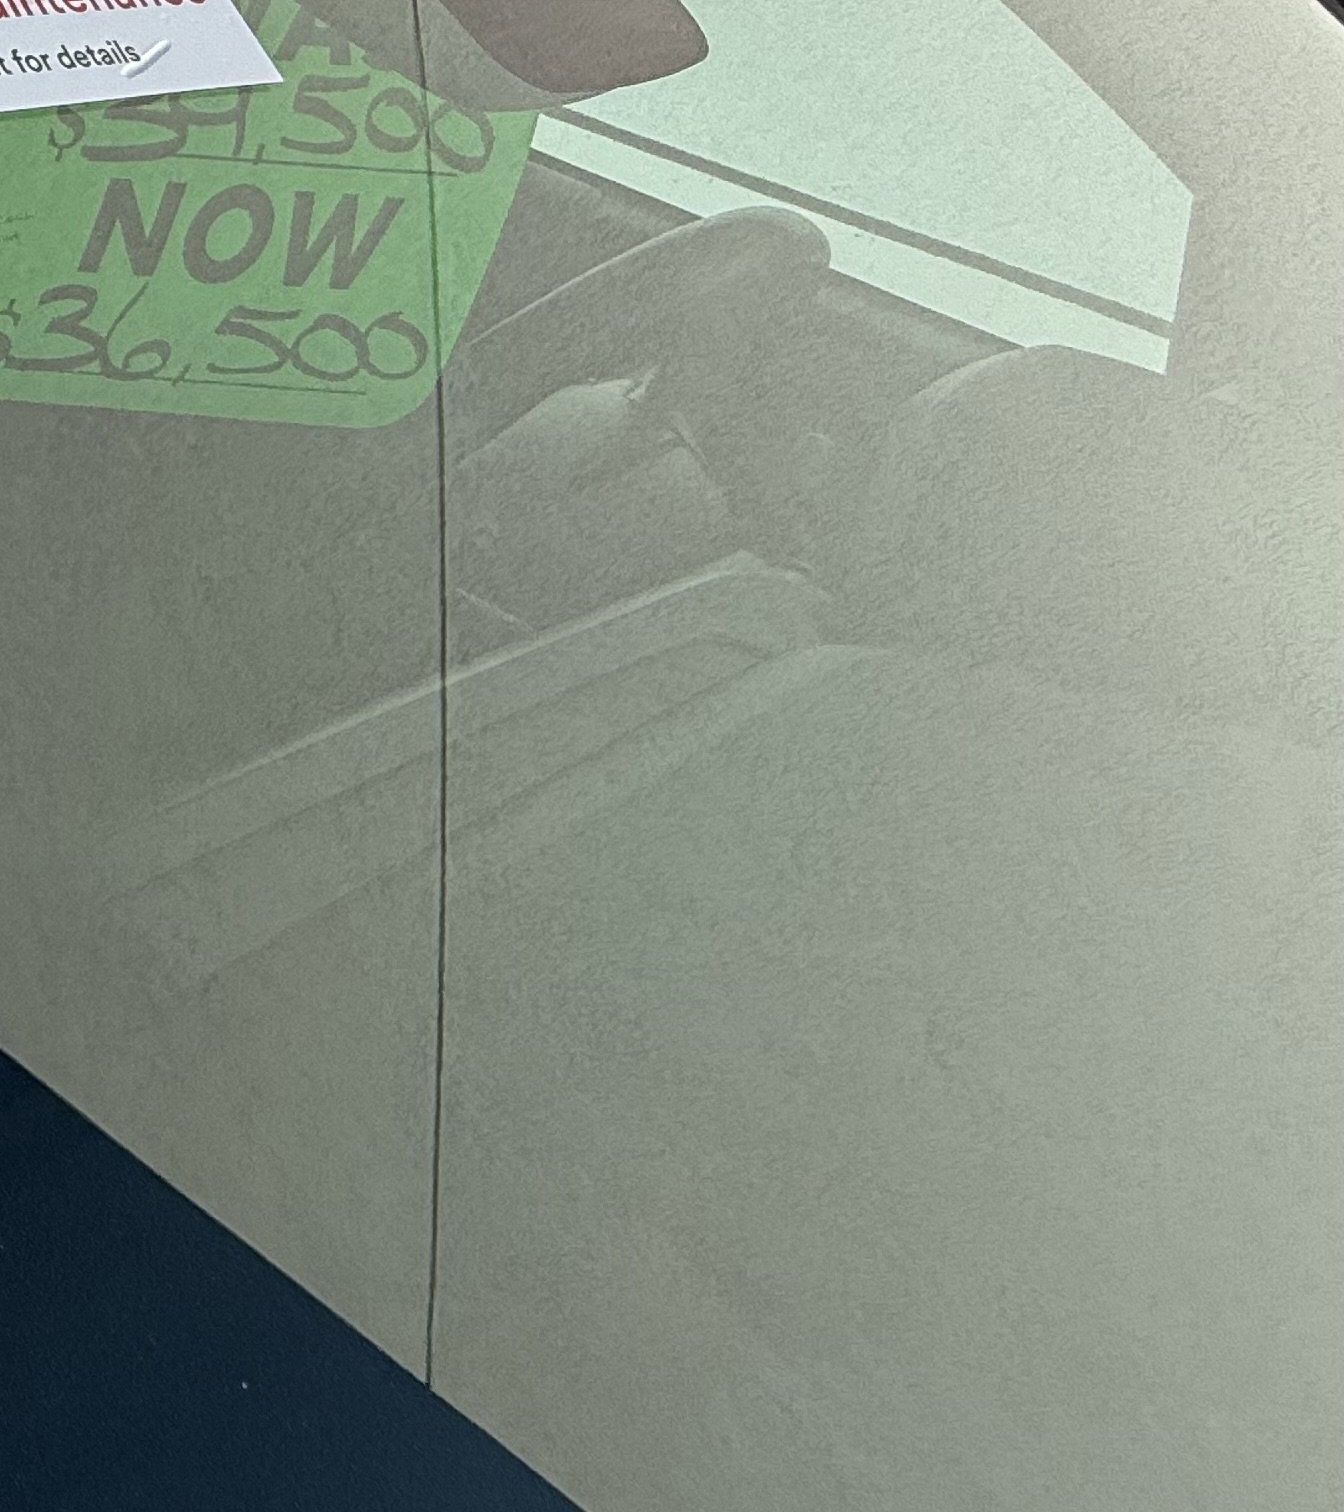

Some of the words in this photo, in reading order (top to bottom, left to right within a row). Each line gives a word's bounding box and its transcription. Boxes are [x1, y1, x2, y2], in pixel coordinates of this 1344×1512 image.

[12, 48, 53, 74] for
[57, 40, 142, 70] details
[76, 177, 406, 290] NOW
